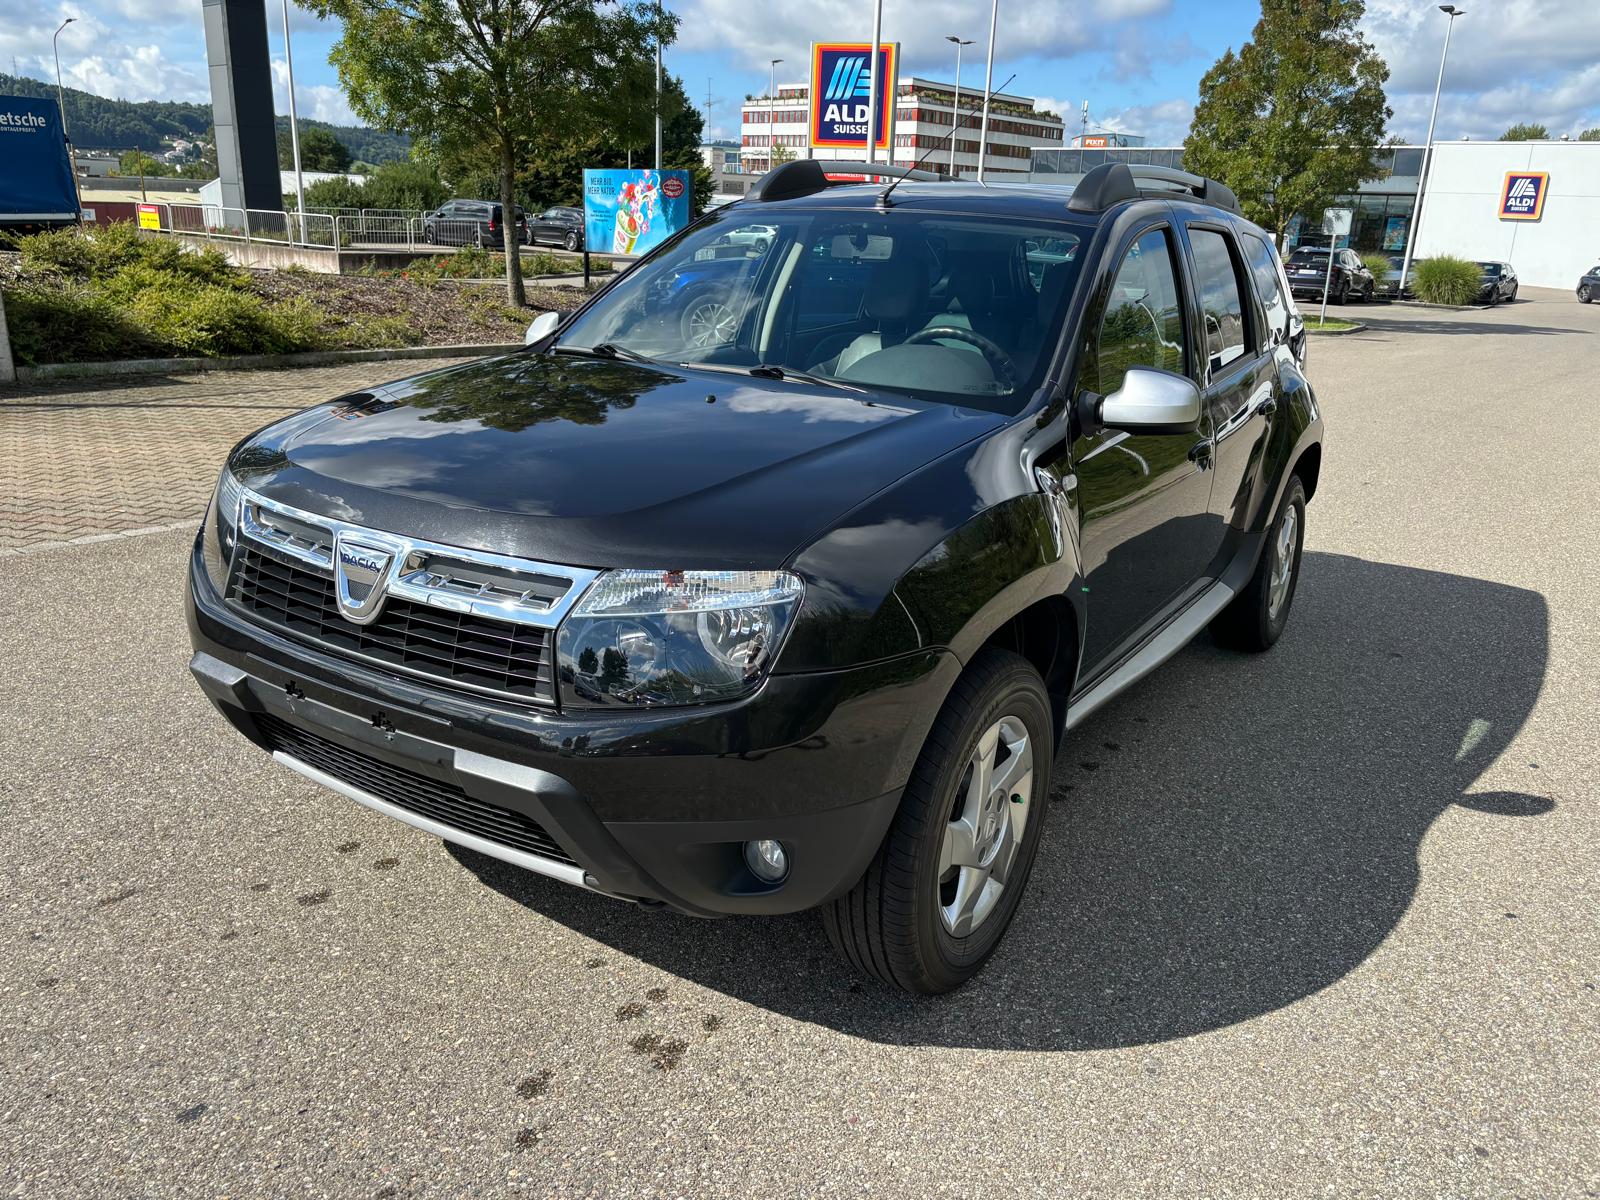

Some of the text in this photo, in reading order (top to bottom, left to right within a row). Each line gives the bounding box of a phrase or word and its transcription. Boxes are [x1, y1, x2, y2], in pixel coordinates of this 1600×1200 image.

[824, 103, 870, 123] ALD
[833, 124, 868, 134] SUISSE
[1507, 197, 1535, 207] ALDI
[342, 553, 381, 573] DACIA
